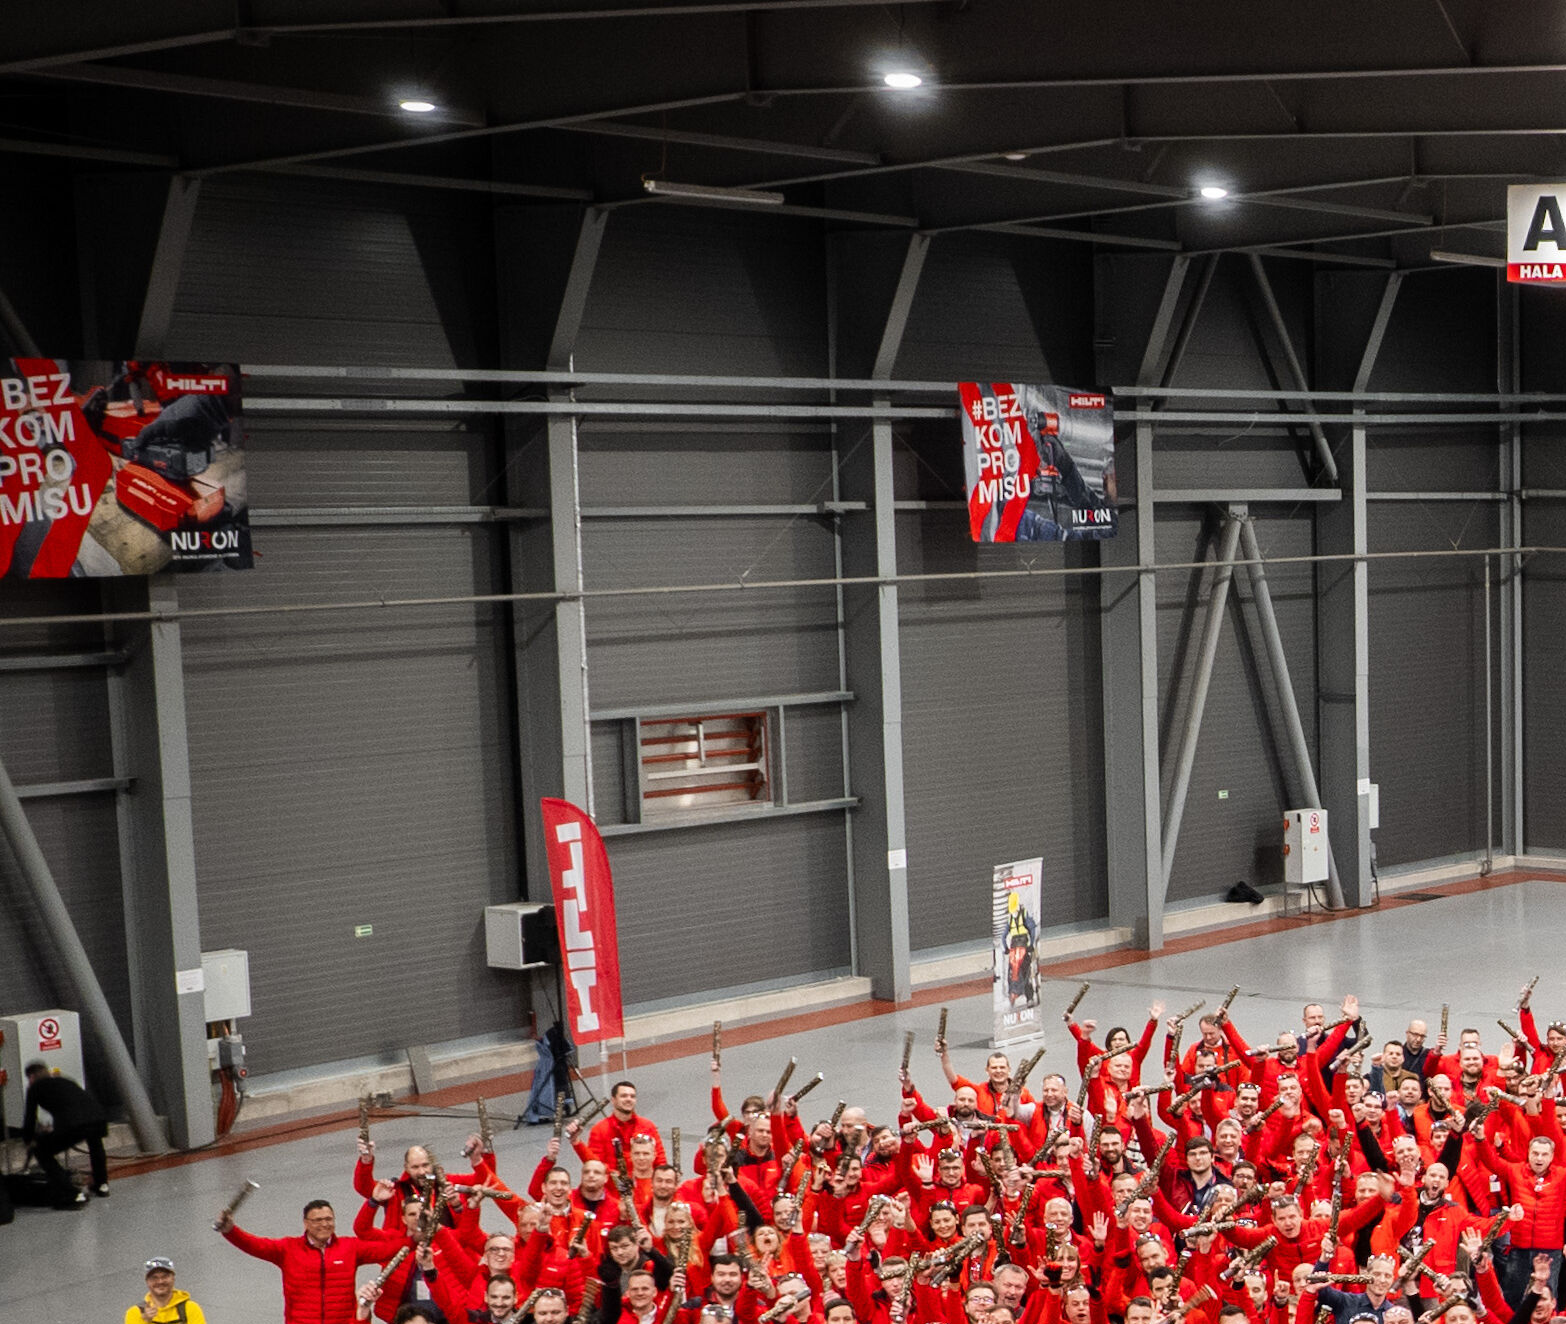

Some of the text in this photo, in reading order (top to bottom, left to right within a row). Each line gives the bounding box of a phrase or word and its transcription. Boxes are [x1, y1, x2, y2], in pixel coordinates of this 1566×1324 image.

[1519, 265, 1563, 279] HALA
[1, 373, 75, 410] BEZ
[166, 378, 226, 391] HILTI
[972, 394, 1022, 421] #BEZ
[974, 421, 1022, 449] KOM
[977, 449, 1020, 476] PRO
[978, 473, 1031, 504] MISU
[171, 530, 239, 551] NURON
[556, 821, 600, 1034] HILTI
